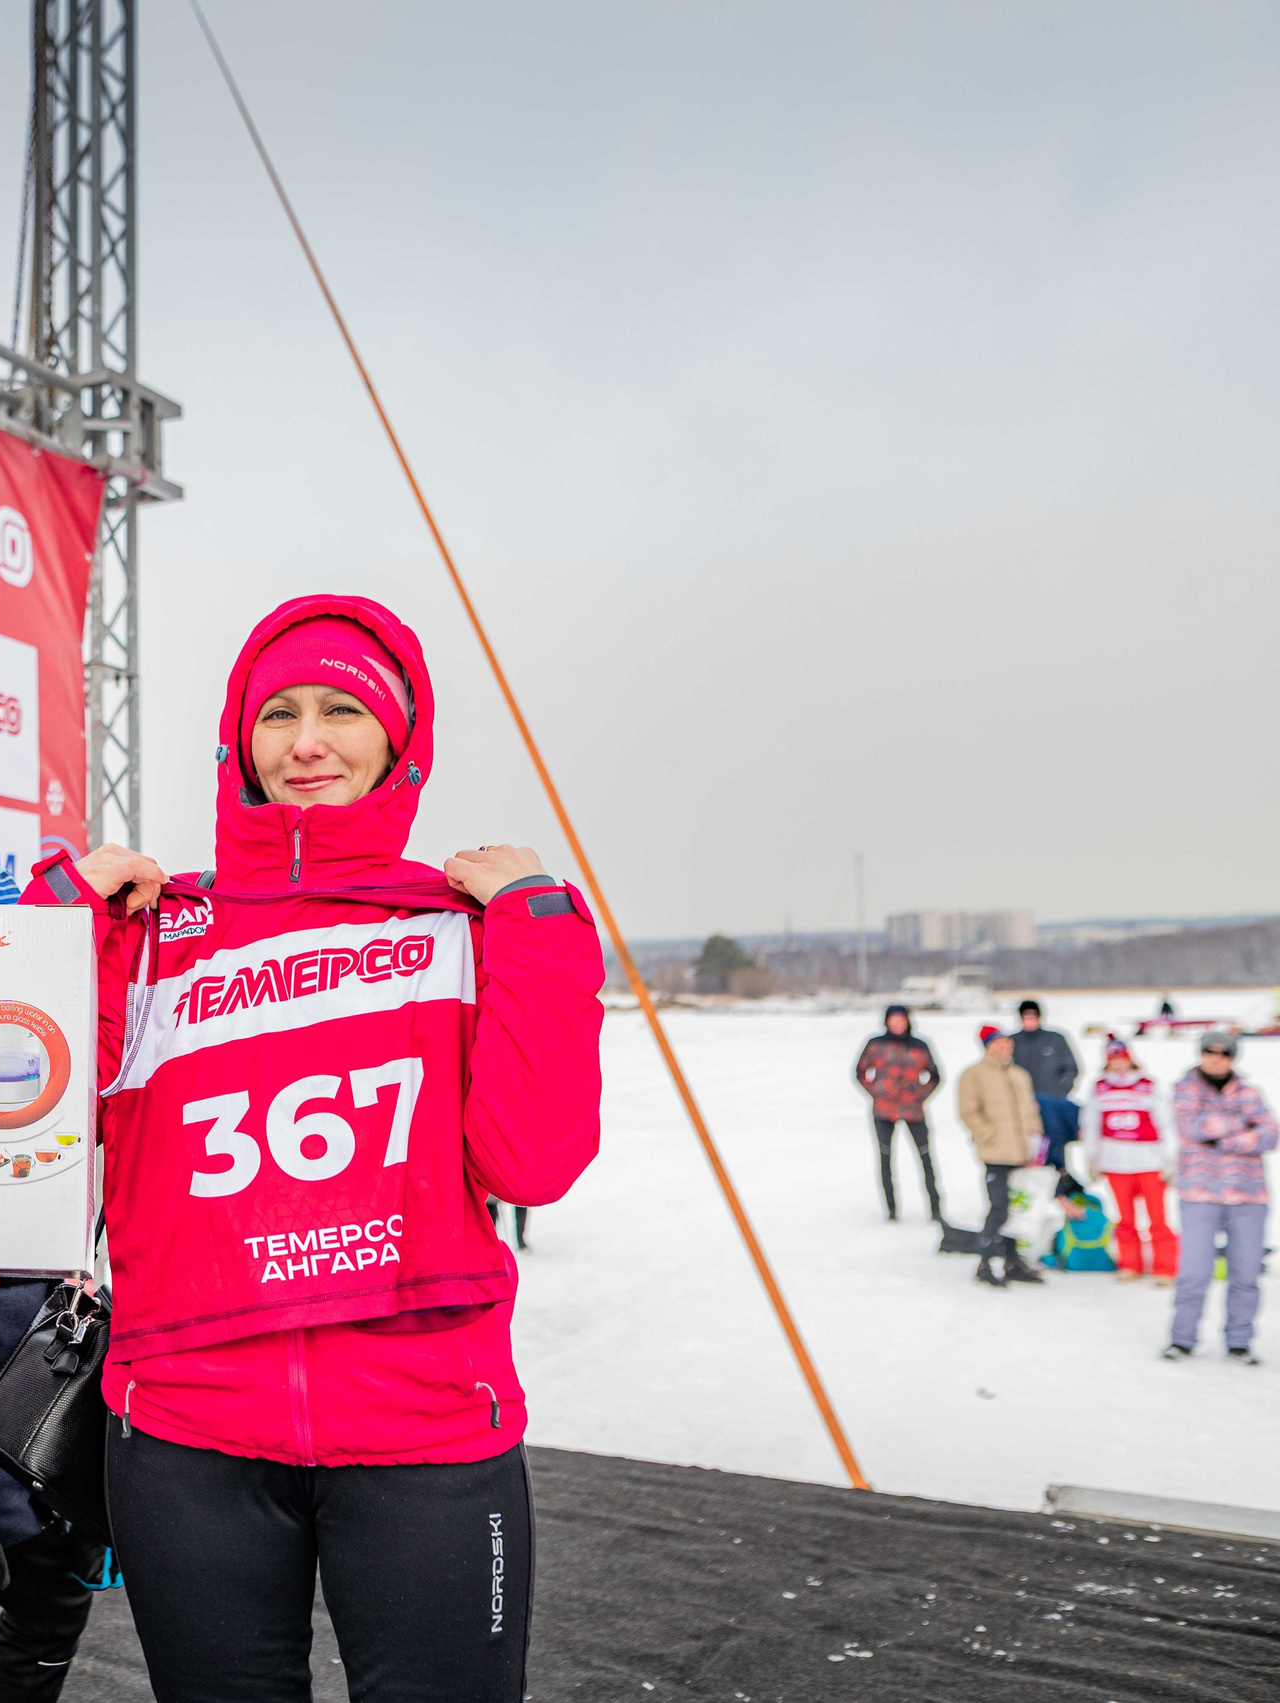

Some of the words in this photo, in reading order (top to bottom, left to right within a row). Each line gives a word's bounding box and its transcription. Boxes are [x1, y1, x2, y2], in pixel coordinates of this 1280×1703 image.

[320, 657, 387, 701] NORDSKI
[172, 933, 435, 1031] ТЕМЕРСО
[0, 1003, 24, 1015] boiling
[24, 1007, 44, 1022] water
[41, 1018, 49, 1027] in
[47, 1024, 57, 1035] an
[12, 1014, 31, 1025] glass
[30, 1020, 48, 1037] kettle
[182, 1057, 425, 1198] 367
[243, 1214, 404, 1259] ТЕМЕРСО
[260, 1242, 401, 1284] АНГАРА
[488, 1512, 504, 1634] NORDSKI
